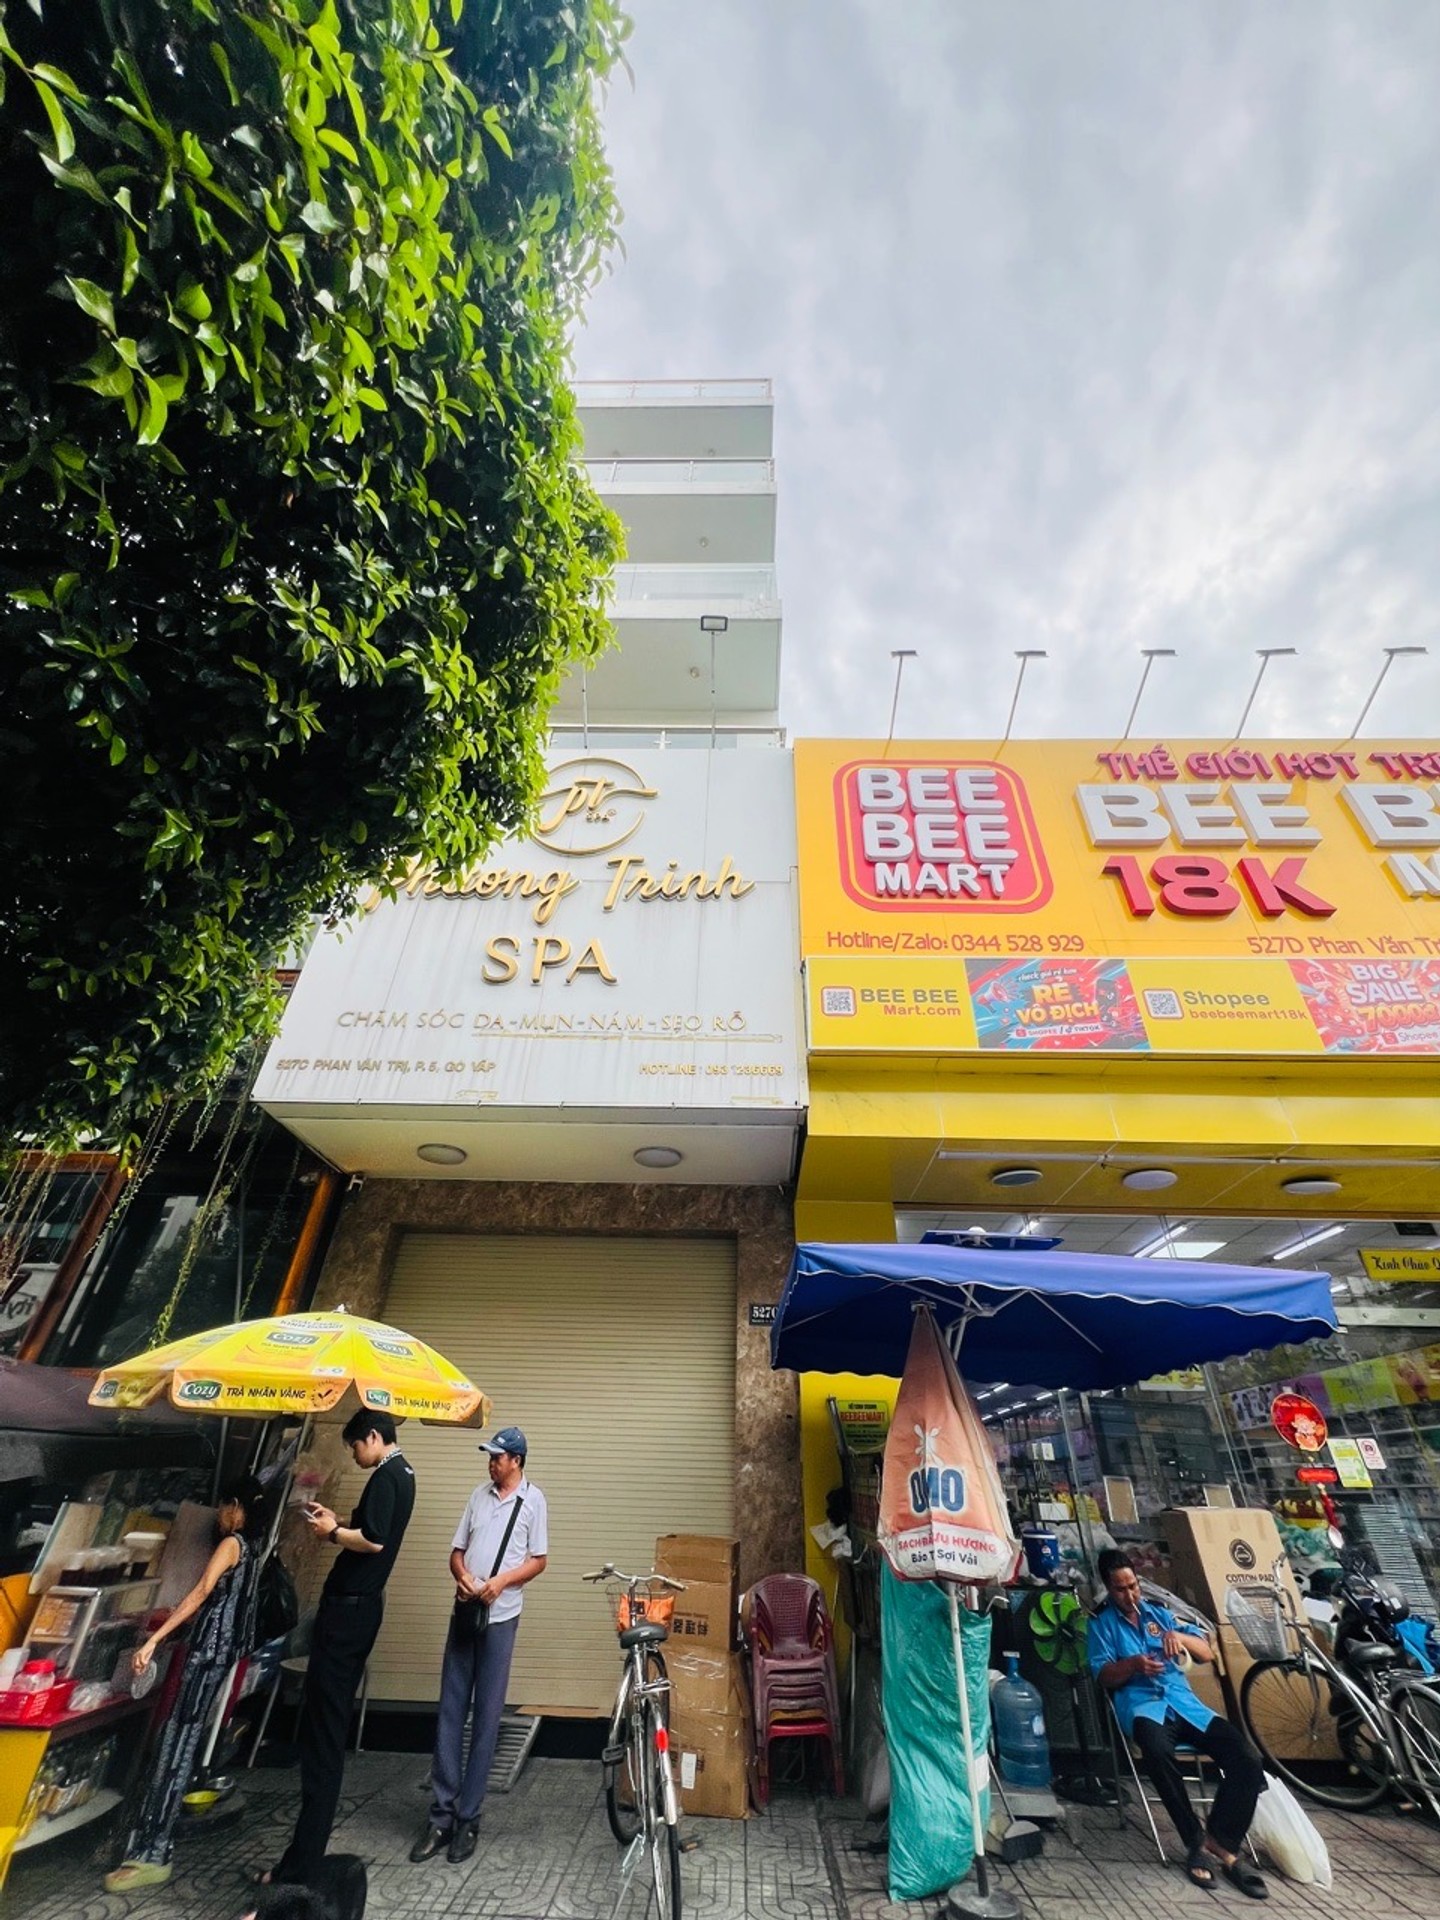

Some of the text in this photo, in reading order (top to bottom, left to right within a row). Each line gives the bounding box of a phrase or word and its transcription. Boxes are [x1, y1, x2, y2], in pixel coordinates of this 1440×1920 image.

[1098, 743, 1179, 780] THẾ
[1185, 747, 1273, 780] GIỚI
[1275, 752, 1359, 780] HOT
[857, 768, 1006, 814] BEE
[1074, 784, 1323, 848] BEE
[863, 813, 1019, 863] BEE
[603, 855, 756, 911] Trinh
[875, 862, 1010, 897] MART
[1102, 855, 1337, 917] 18K
[951, 935, 1001, 951] 0344
[1006, 935, 1043, 951] 528
[1049, 935, 1084, 951] 929
[1247, 937, 1304, 954] 527D
[1307, 937, 1368, 954] Phan
[1367, 936, 1415, 954] Văn
[482, 936, 618, 985] SPA
[1350, 964, 1398, 980] BIG
[861, 988, 959, 1004] BEE BEE
[1184, 991, 1270, 1009] Shopee
[337, 1010, 408, 1028] CHĂM
[416, 1008, 464, 1029] SÓC
[884, 1005, 961, 1016] Mart.com
[1190, 1009, 1307, 1020] beebeemart18k
[313, 1059, 350, 1071] PHAN
[183, 1382, 219, 1398] Cozy
